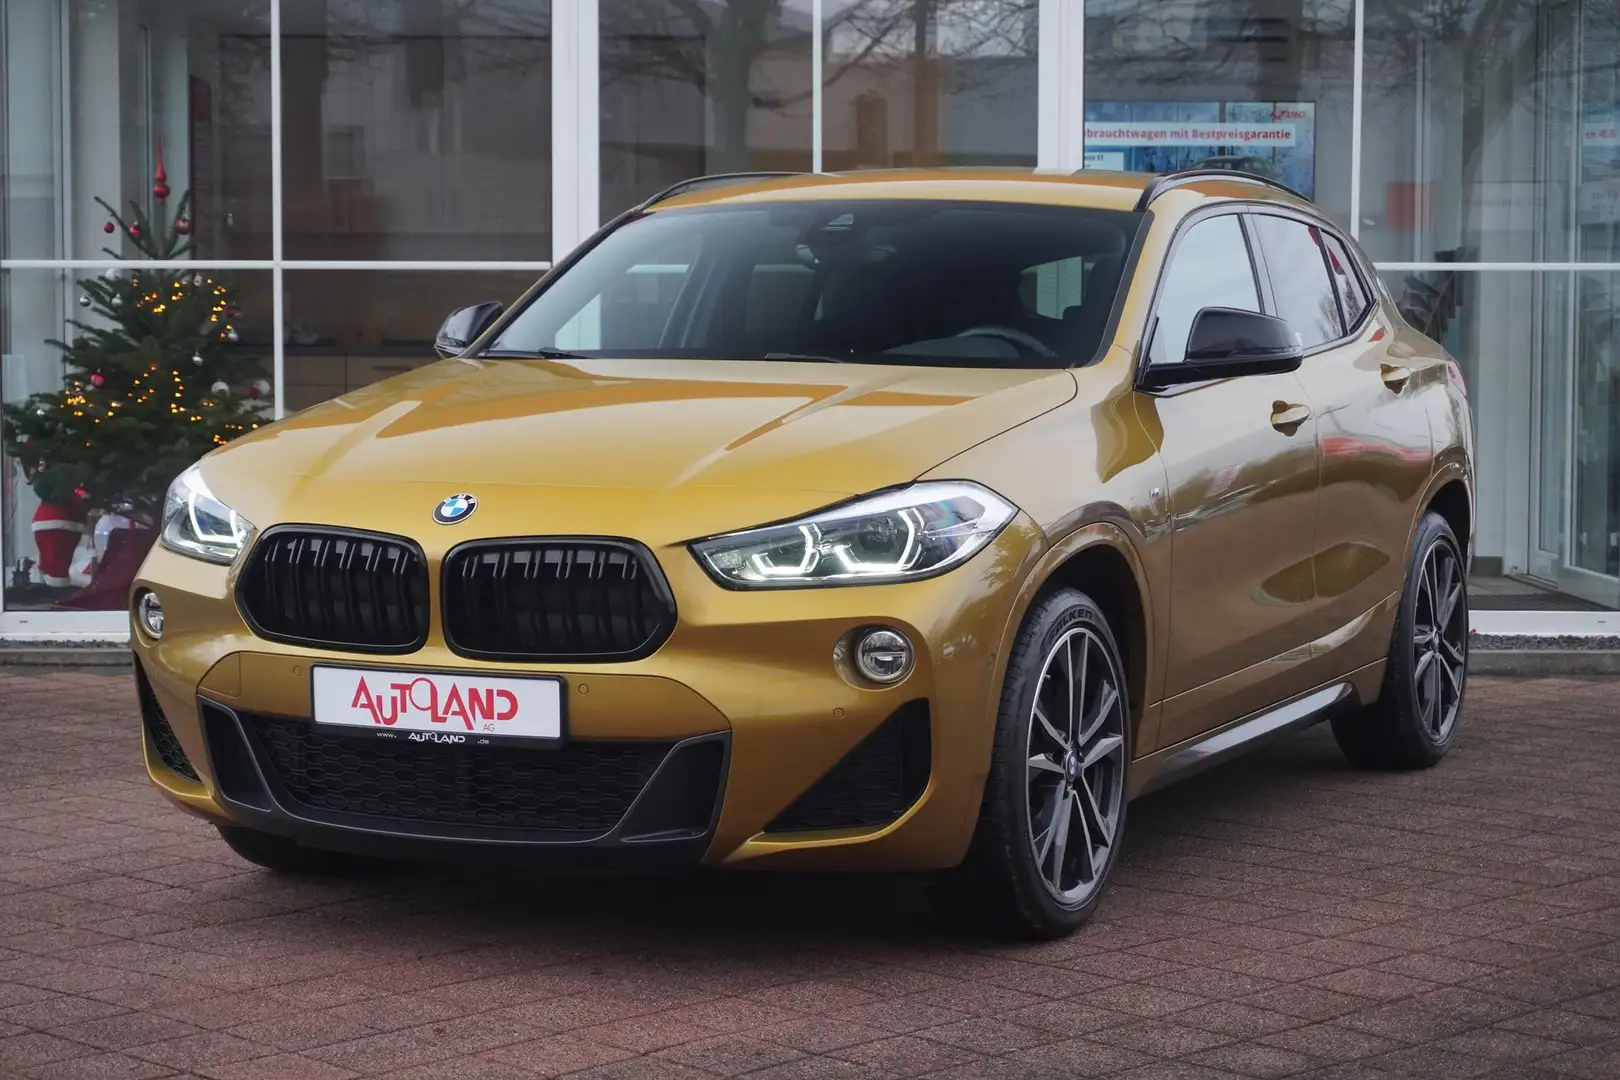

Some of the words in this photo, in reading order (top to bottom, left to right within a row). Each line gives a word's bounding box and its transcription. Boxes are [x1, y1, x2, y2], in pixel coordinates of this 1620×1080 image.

[1085, 128, 1166, 141] brauchtwagen
[1170, 128, 1188, 139] mit
[1192, 128, 1291, 141] Bestpreisgarantie
[482, 723, 495, 732] AG
